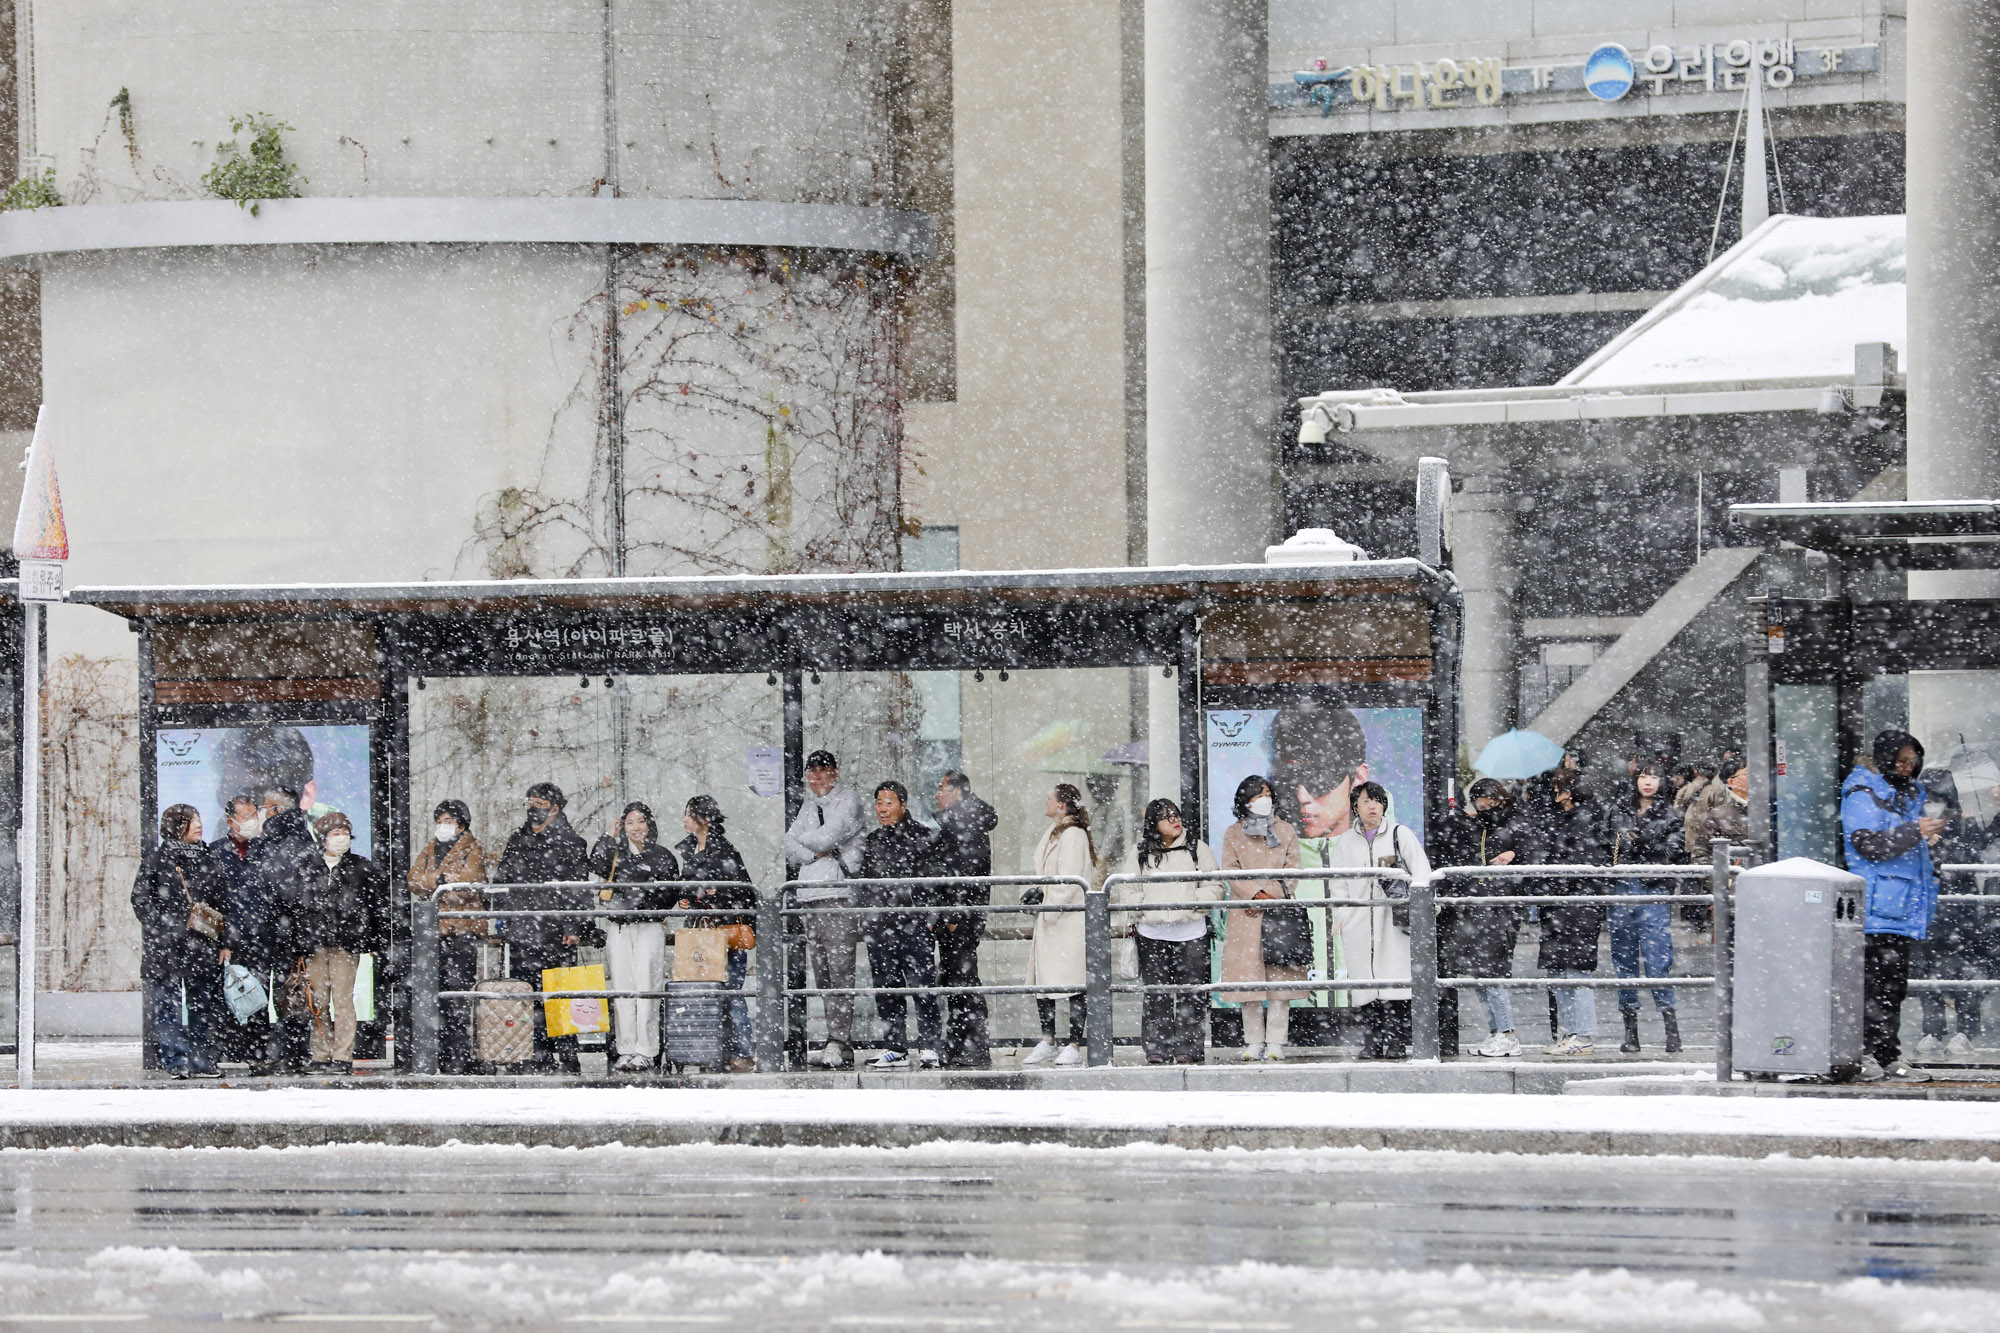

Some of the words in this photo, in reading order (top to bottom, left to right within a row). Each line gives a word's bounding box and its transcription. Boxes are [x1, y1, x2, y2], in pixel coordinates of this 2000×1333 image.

[1350, 57, 1501, 111] 하나은행
[1531, 67, 1555, 90] 1F
[1639, 38, 1796, 96] 우리은행
[1820, 49, 1844, 73] 3F
[504, 626, 674, 650] 용산역(아이파크몰)
[943, 621, 981, 641] 택시
[989, 620, 1028, 640] 승차
